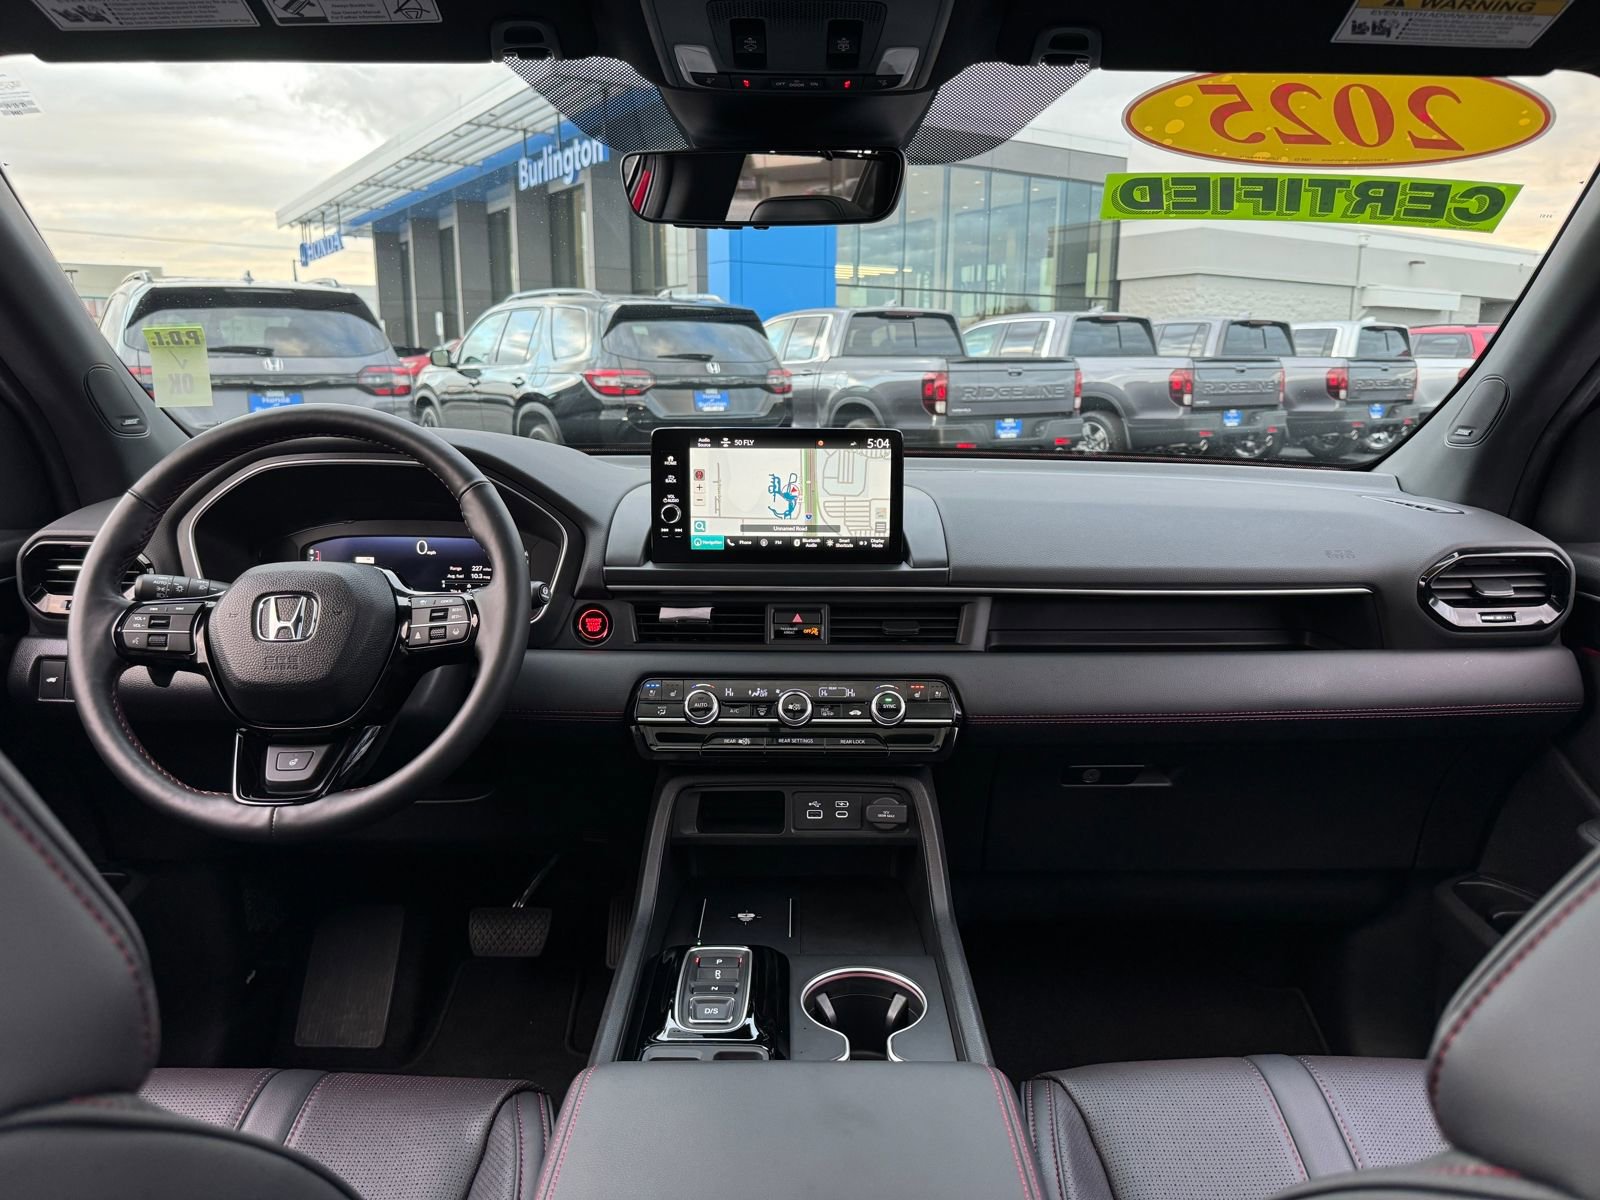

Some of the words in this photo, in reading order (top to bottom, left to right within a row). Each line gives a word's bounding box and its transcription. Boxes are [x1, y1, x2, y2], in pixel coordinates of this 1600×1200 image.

[1420, 0, 1537, 12] WARNING
[518, 138, 604, 191] Burlington
[961, 384, 1065, 401] RIDGELINE
[1202, 382, 1275, 394] RIDGELINE
[867, 438, 890, 449] 5:04
[416, 540, 428, 555] 0
